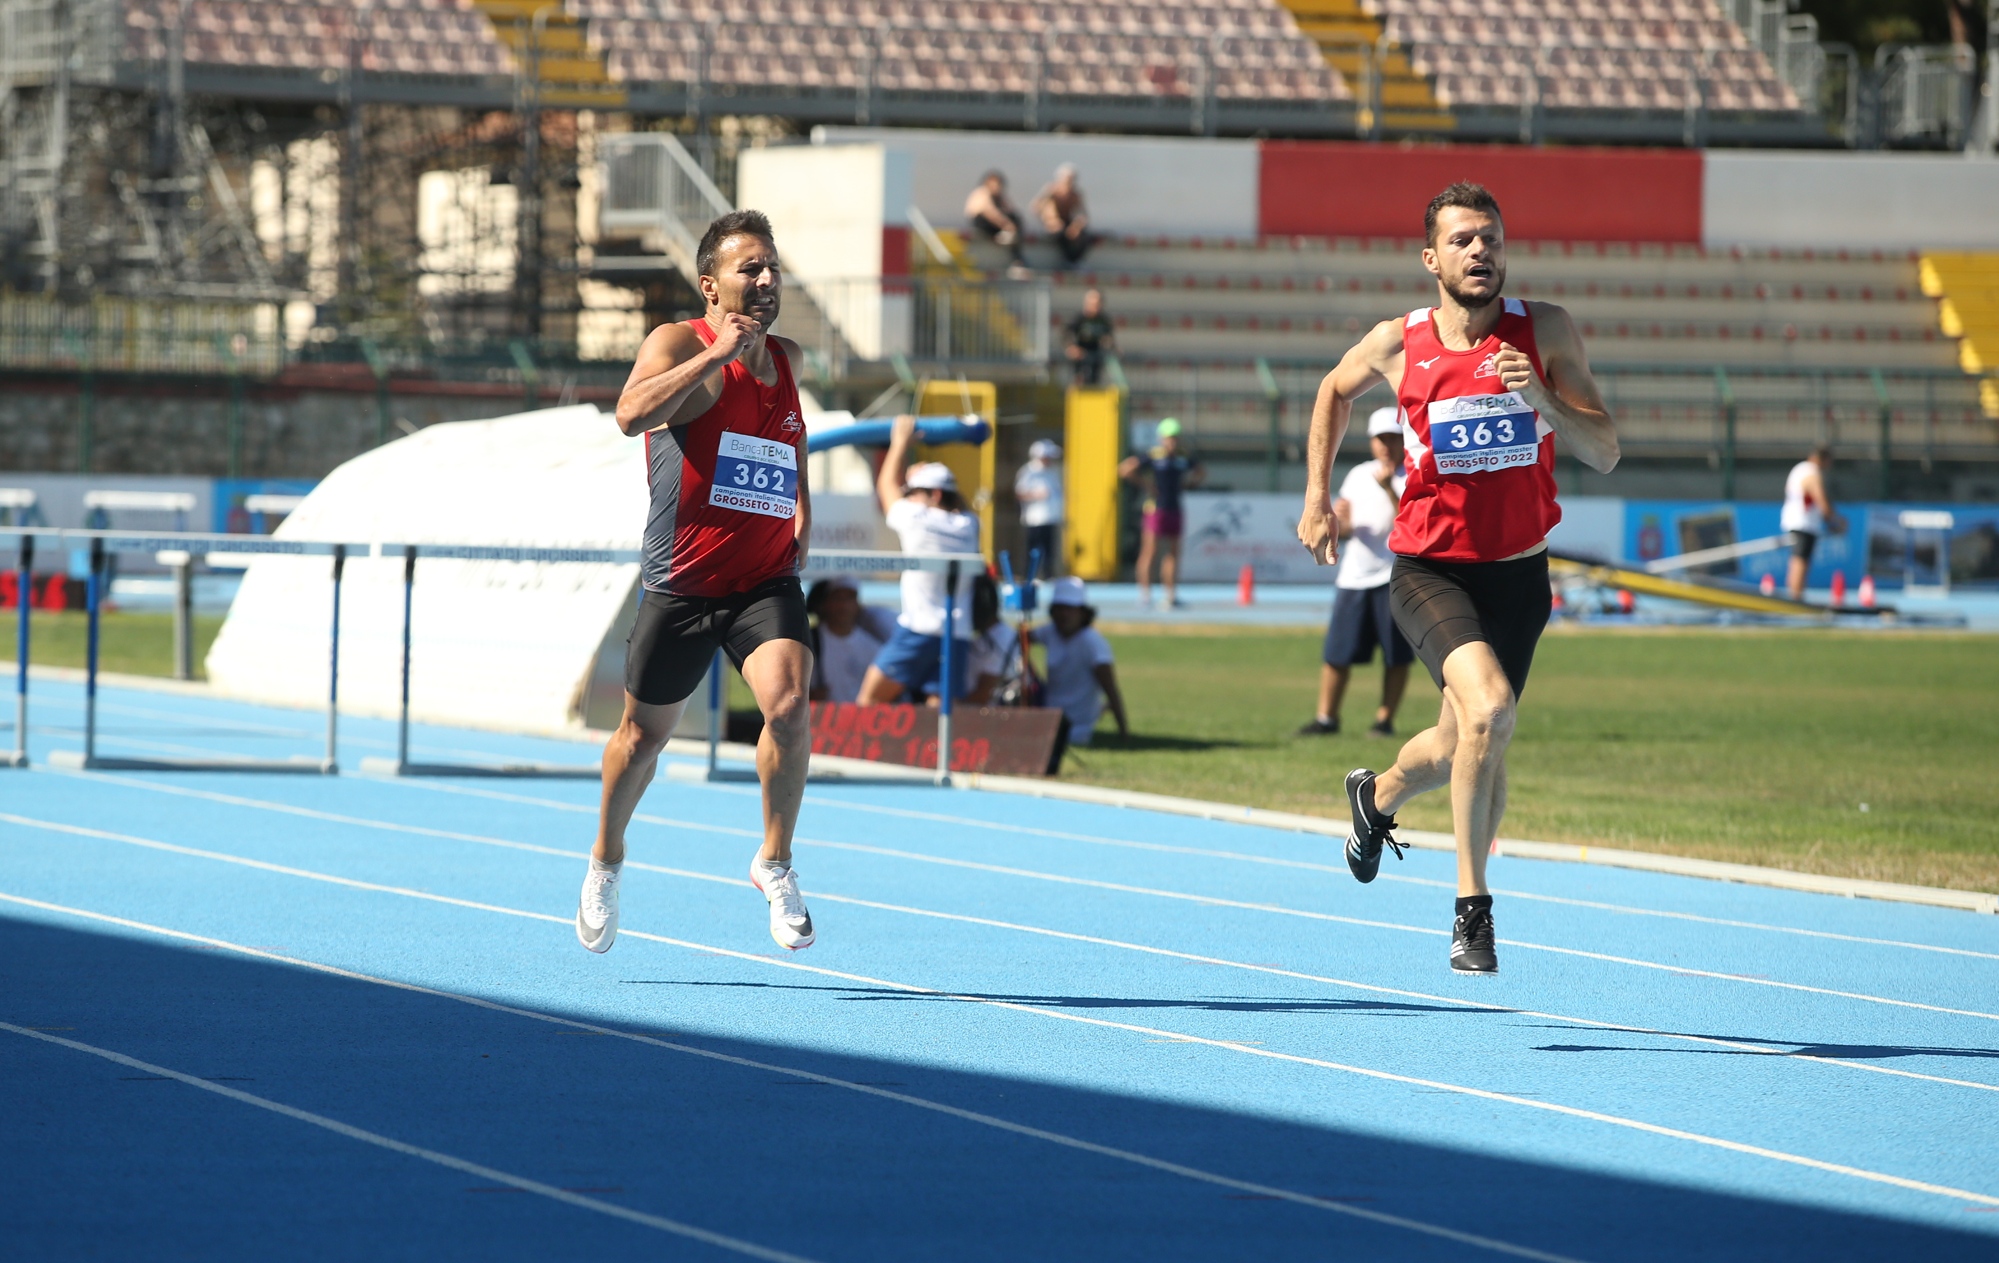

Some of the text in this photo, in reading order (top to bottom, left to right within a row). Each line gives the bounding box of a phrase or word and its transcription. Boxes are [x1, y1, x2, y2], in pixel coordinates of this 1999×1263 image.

[1450, 419, 1516, 448] 363
[731, 439, 789, 461] BancaTEMA
[1438, 445, 1533, 460] campionati italiani master
[1440, 452, 1533, 469] GROSSETO 2022
[733, 463, 785, 492] 362
[713, 493, 793, 516] GROSSETO 2022
[715, 487, 794, 506] campionati italiani master
[837, 556, 921, 570] GROSSETO
